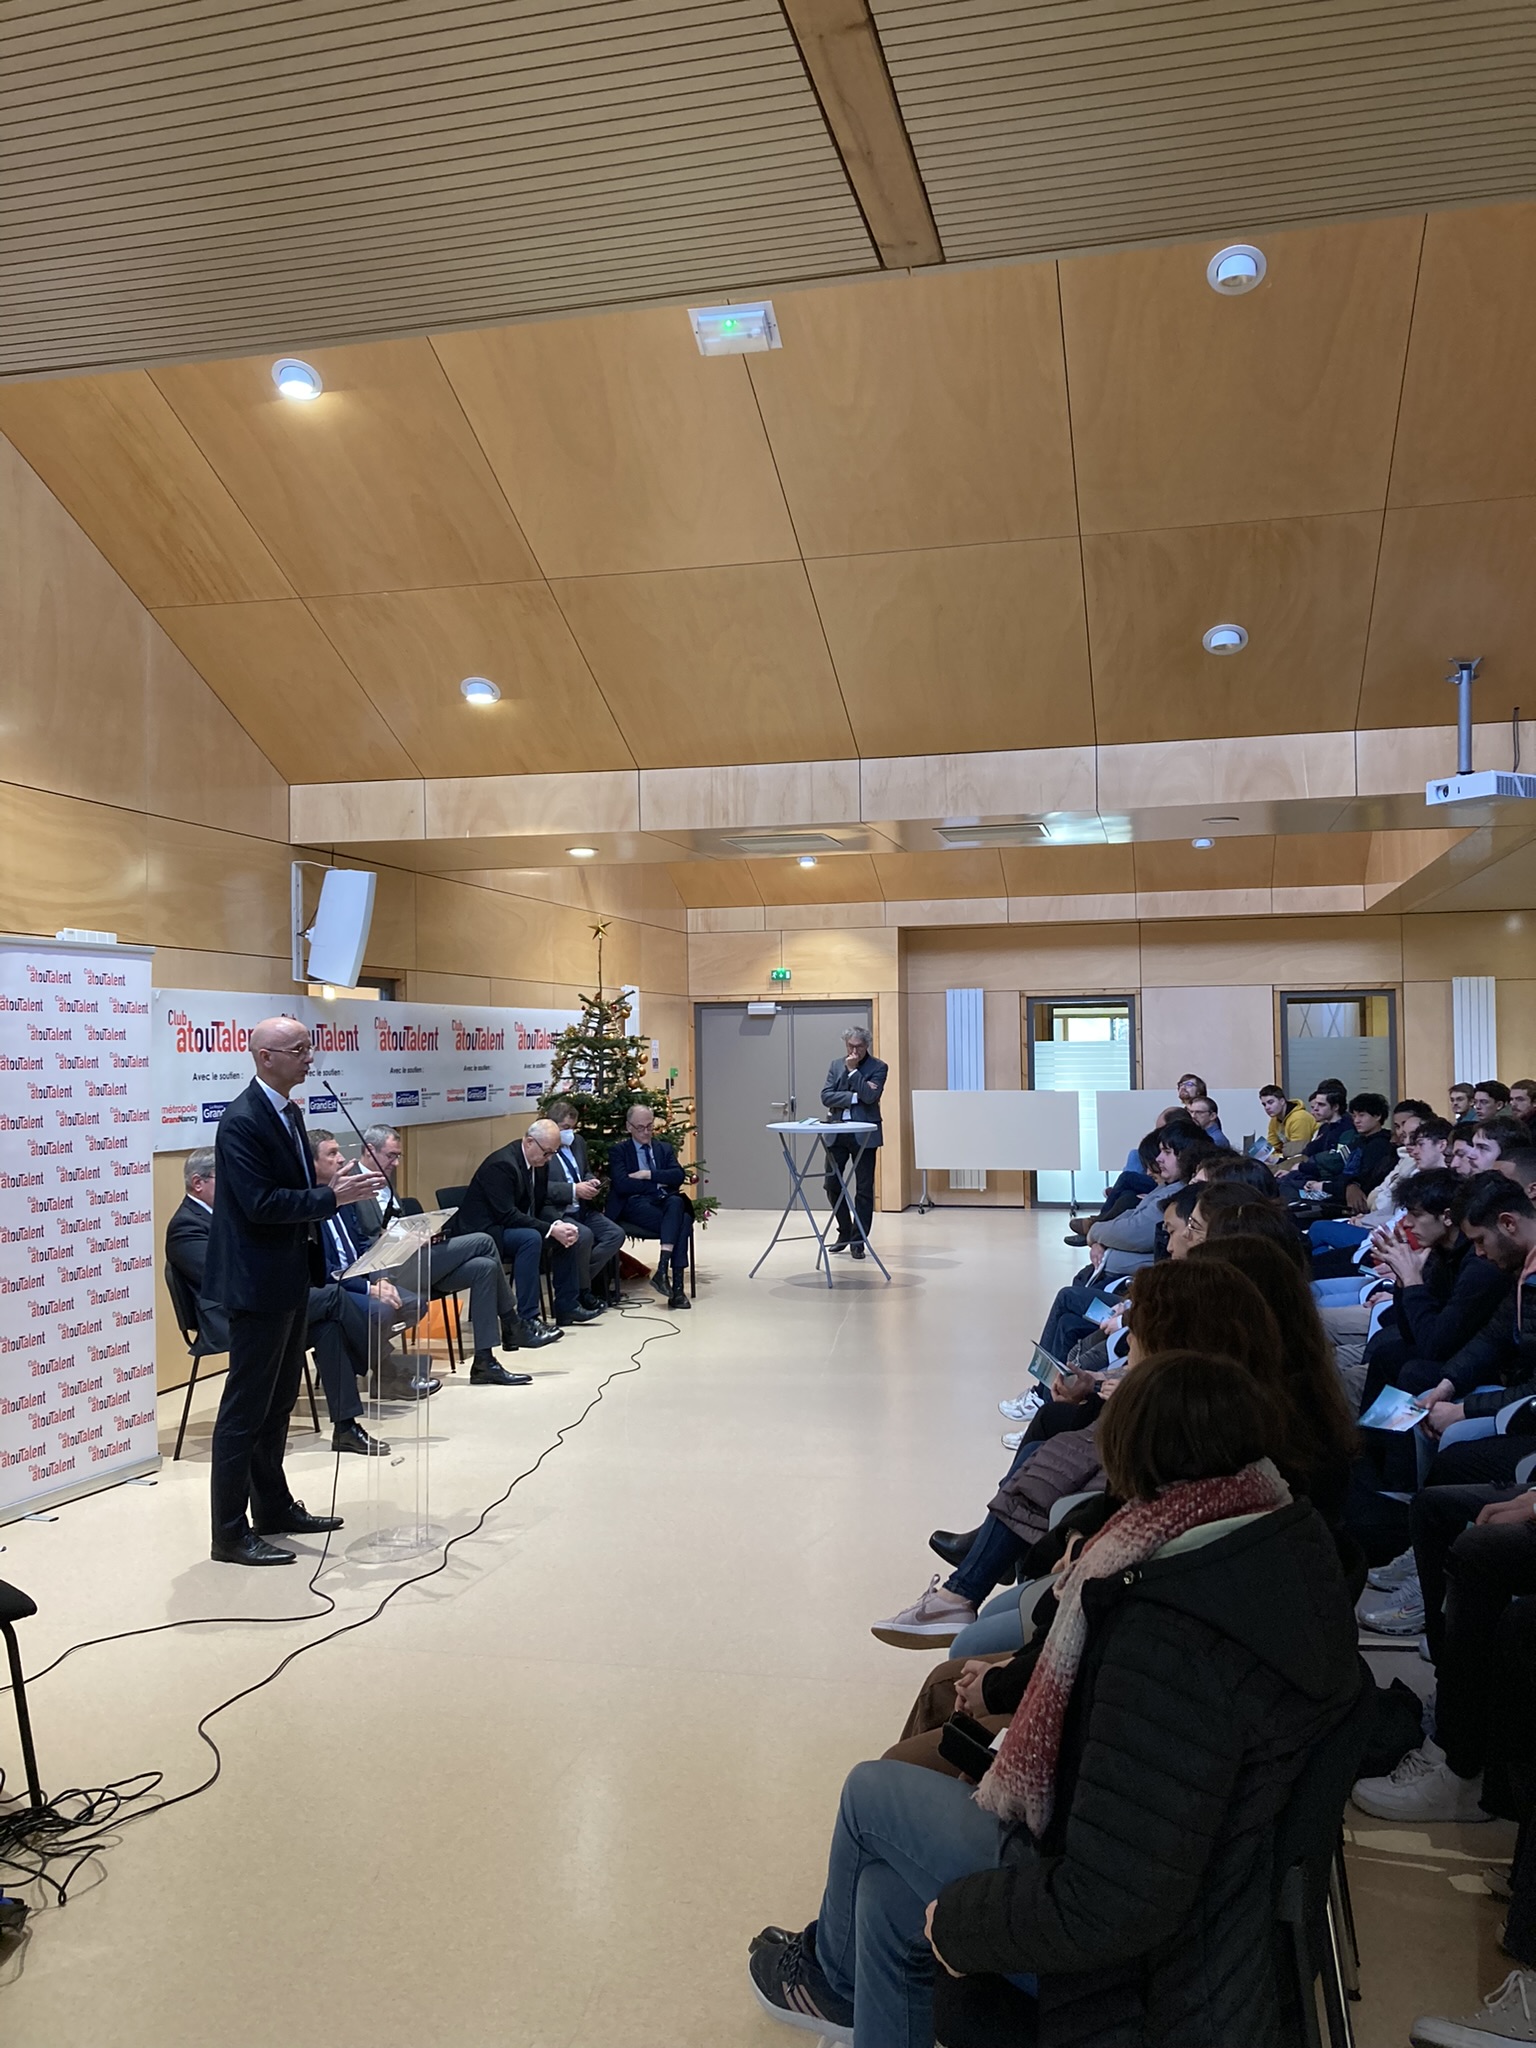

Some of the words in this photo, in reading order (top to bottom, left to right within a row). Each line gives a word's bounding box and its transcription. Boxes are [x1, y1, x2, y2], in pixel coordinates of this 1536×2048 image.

[30, 970, 72, 984] atouTalent
[88, 973, 125, 986] atouTalent
[0, 998, 43, 1012] atouTalent
[59, 1000, 98, 1013] atouTalent
[113, 1001, 148, 1014] atouTalent
[168, 1010, 187, 1026] Club
[31, 1028, 72, 1040] atouTalent
[88, 1028, 126, 1040] atouTalent
[176, 1020, 254, 1052] atouTale
[308, 1022, 360, 1052] uTalent
[380, 1024, 439, 1052] atouTalent
[455, 1026, 504, 1051] atouTalent
[1, 1056, 43, 1070] atouTalent
[60, 1056, 99, 1069] atouTalent
[113, 1055, 149, 1068] atouTalent
[192, 1072, 210, 1081] Avec
[212, 1072, 218, 1080] le
[31, 1085, 72, 1099] atouTalent
[89, 1083, 127, 1096] atouTalent
[114, 1109, 150, 1123] atouTalent
[162, 1104, 198, 1114] métropole
[1, 1115, 43, 1130] atouTalent
[60, 1112, 100, 1126] atouTalent
[31, 1141, 72, 1156] atouTalent
[89, 1136, 128, 1151] atouTalent
[60, 1166, 100, 1182] atouTalent
[114, 1161, 150, 1176] atouTalent
[1, 1172, 44, 1188] atouTalent
[31, 1196, 73, 1213] atouTalent
[90, 1189, 128, 1206] atouTalent
[61, 1217, 101, 1234] atouTalent
[115, 1210, 151, 1226] atouTalent
[1, 1225, 44, 1243] atouTalent
[90, 1236, 129, 1253] atouTalent
[31, 1244, 74, 1263] atouTalent
[115, 1255, 152, 1272] atouTalent
[61, 1264, 102, 1282] atouTalent
[2, 1274, 44, 1294] atouTalent
[90, 1286, 129, 1305] atouTalent
[32, 1297, 74, 1317] atouTalent
[116, 1308, 153, 1327] atouTalent
[62, 1318, 102, 1339] atouTalent
[2, 1331, 45, 1353] atouTalent
[91, 1341, 130, 1361] atouTalent
[32, 1354, 74, 1376] atouTalent
[116, 1362, 154, 1383] atouTalent
[62, 1376, 102, 1398] atouTalent
[2, 1390, 46, 1415] atouTalent
[92, 1390, 130, 1412] atouTalent
[32, 1406, 75, 1430] atouTalent
[117, 1409, 154, 1431] atouTalent
[62, 1425, 102, 1448] atouTalent
[2, 1442, 46, 1468] atouTalent
[92, 1438, 131, 1461] atouTalent
[32, 1456, 75, 1481] atouTalent
